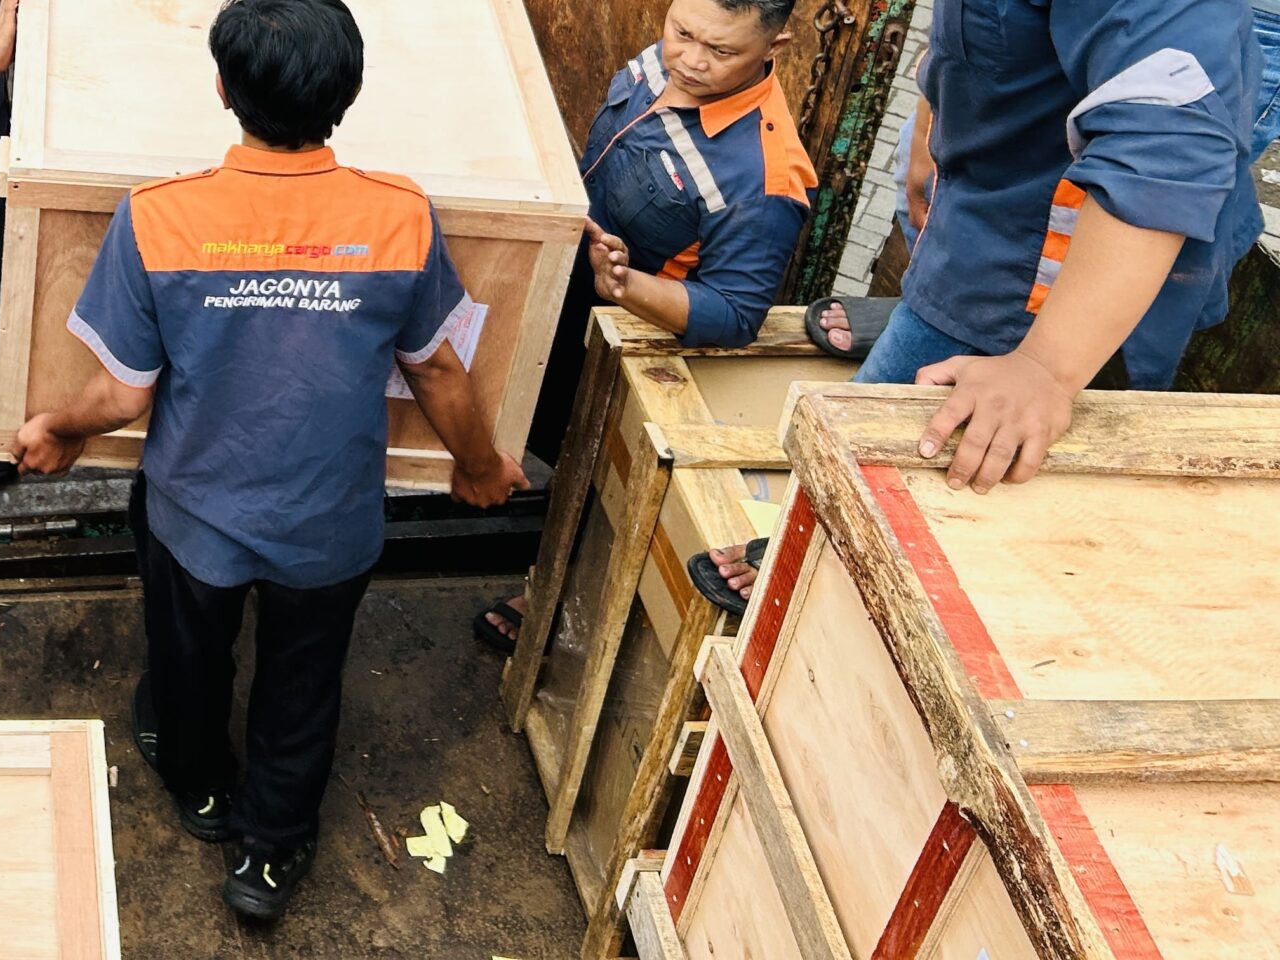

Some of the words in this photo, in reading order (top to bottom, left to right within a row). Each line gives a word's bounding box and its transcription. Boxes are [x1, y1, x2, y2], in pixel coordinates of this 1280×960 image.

[201, 240, 369, 259] makharyacargo.com
[229, 277, 342, 300] JAGONYA
[203, 295, 295, 309] PENGIRIMAN
[297, 297, 363, 313] BARANG
